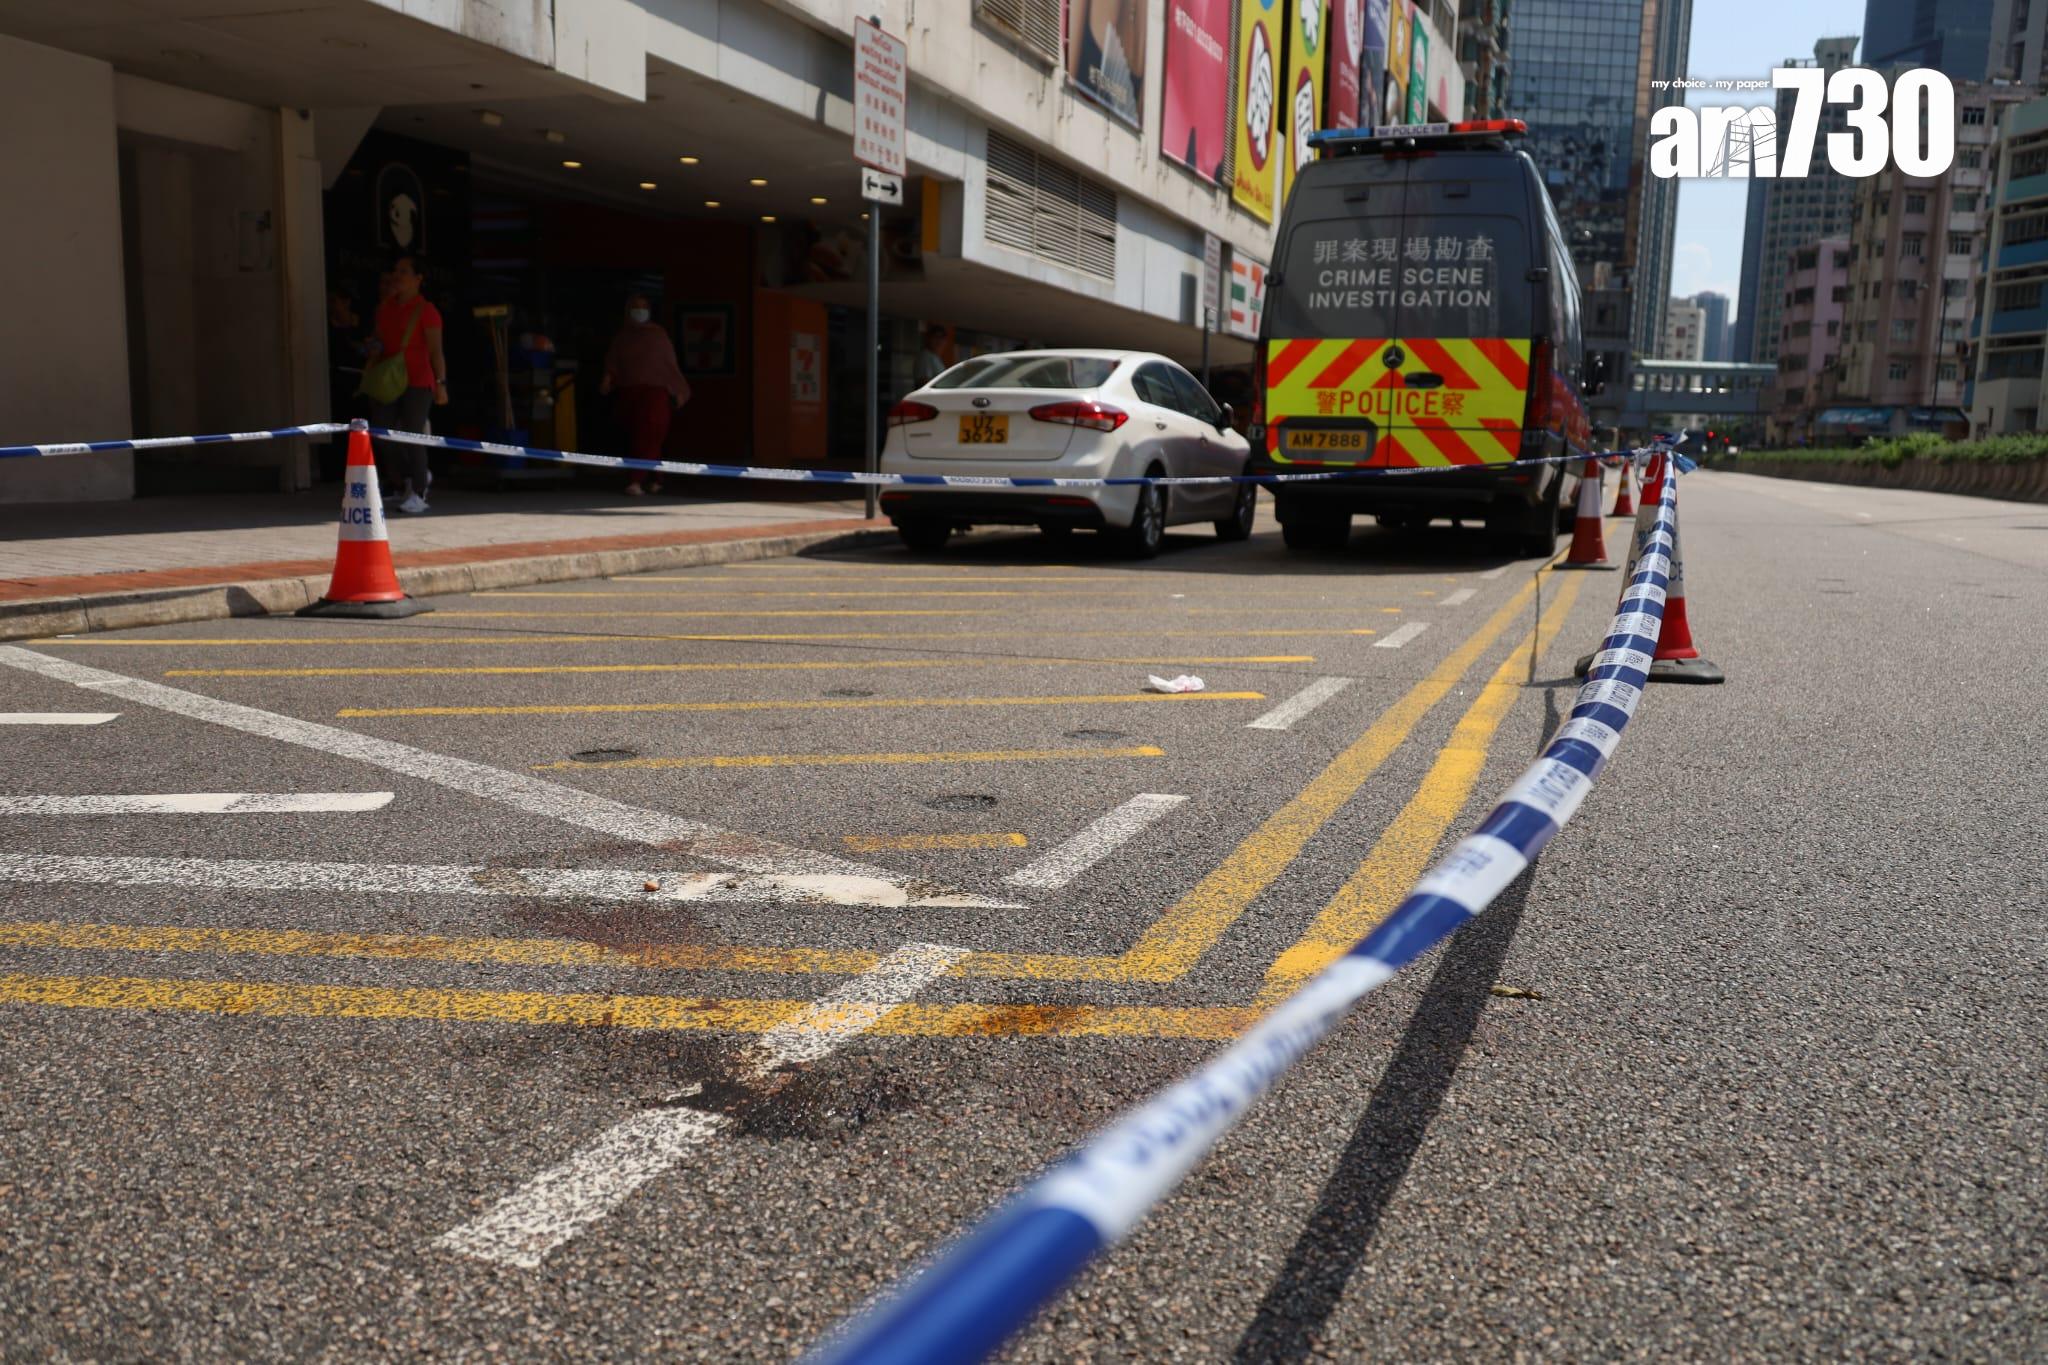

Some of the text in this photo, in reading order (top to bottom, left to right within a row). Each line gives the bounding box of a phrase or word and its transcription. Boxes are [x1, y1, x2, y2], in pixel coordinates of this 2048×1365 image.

[1392, 126, 1430, 136] POLICE
[1312, 236, 1494, 264] 罪案現場勘查
[1319, 268, 1484, 287] CRIME SCENE
[1308, 290, 1492, 308] INVESTIGATION
[1340, 391, 1440, 416] POLICE
[974, 415, 993, 429] UZ
[961, 428, 1006, 443] 3625
[1292, 433, 1362, 448] AM 7888
[1628, 559, 1683, 582] PCE
